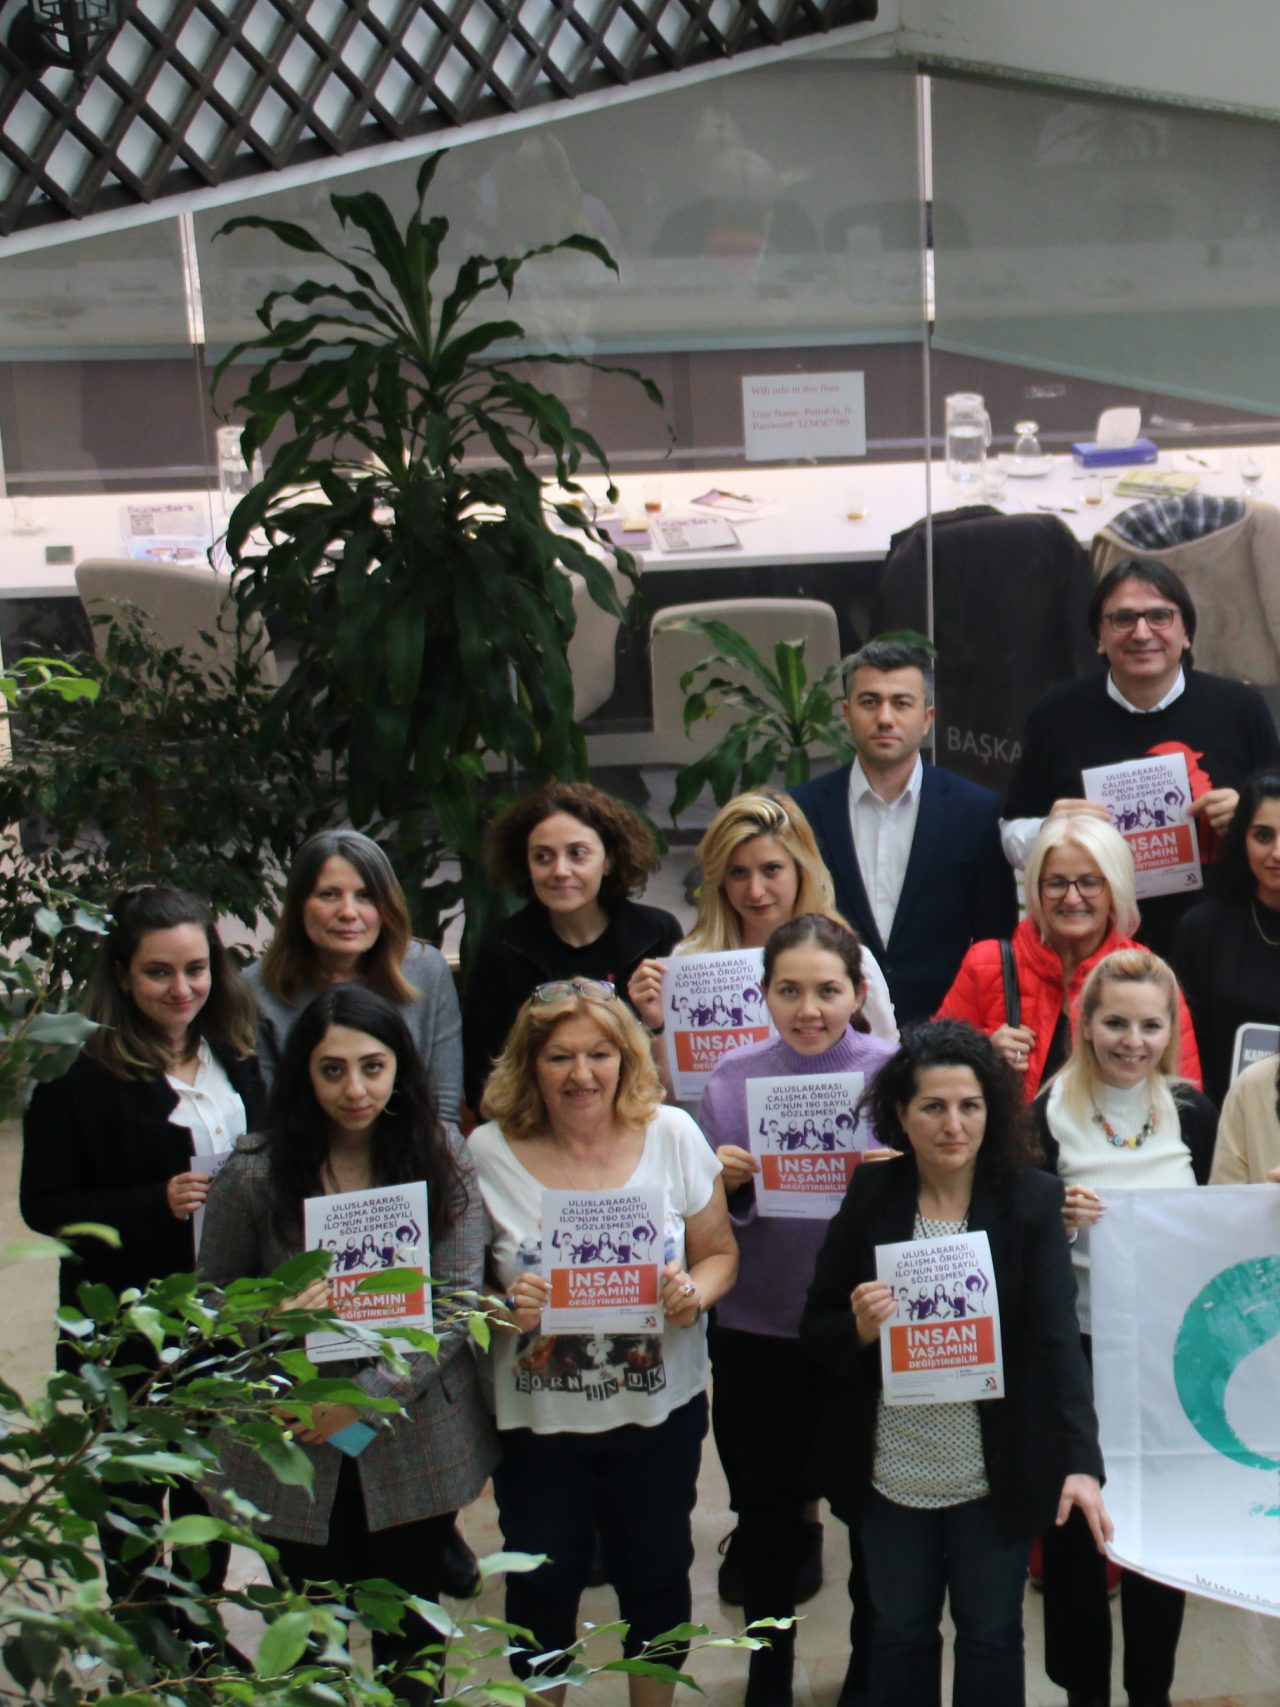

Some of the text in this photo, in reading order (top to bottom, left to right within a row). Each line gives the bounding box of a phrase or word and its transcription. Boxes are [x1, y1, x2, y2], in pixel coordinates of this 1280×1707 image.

[1130, 832, 1176, 851] NSAN
[1135, 847, 1178, 860] ŞAMINI
[682, 960, 747, 972] ULUSLARARASI
[676, 966, 753, 980] ÇALIŞMA ÖRGÜTÜ
[713, 977, 727, 985] 190
[730, 974, 756, 983] SAYILI
[690, 1033, 754, 1050] İNSAN
[773, 1083, 842, 1093] ULUSLARARASI
[767, 1090, 849, 1103] ÇALIŞMA ÖRGÜTÜ
[778, 1155, 845, 1172] İNSAN
[779, 1173, 845, 1183] YAŞAMINI
[332, 1195, 404, 1212] ULUSLARARASI
[569, 1197, 641, 1206] ULUSLARARASI
[326, 1202, 410, 1221] ÇALIŞMA ÖRGÜTÜ
[563, 1204, 647, 1216] ÇALIŞMA ÖRGÜTÜ
[366, 1216, 381, 1224] 190
[384, 1211, 413, 1221] SAYILI
[902, 1243, 968, 1259] ULUSLARARASI
[896, 1250, 975, 1269] ÇALIŞMA ÖRGÜTÜ
[935, 1263, 949, 1272] 190
[952, 1259, 978, 1269] SAYILI
[570, 1267, 641, 1286] İNSAN
[570, 1286, 640, 1298] YAŞAMINI
[907, 1324, 977, 1346] İNSAN
[908, 1342, 977, 1358] YAŞAMINI
